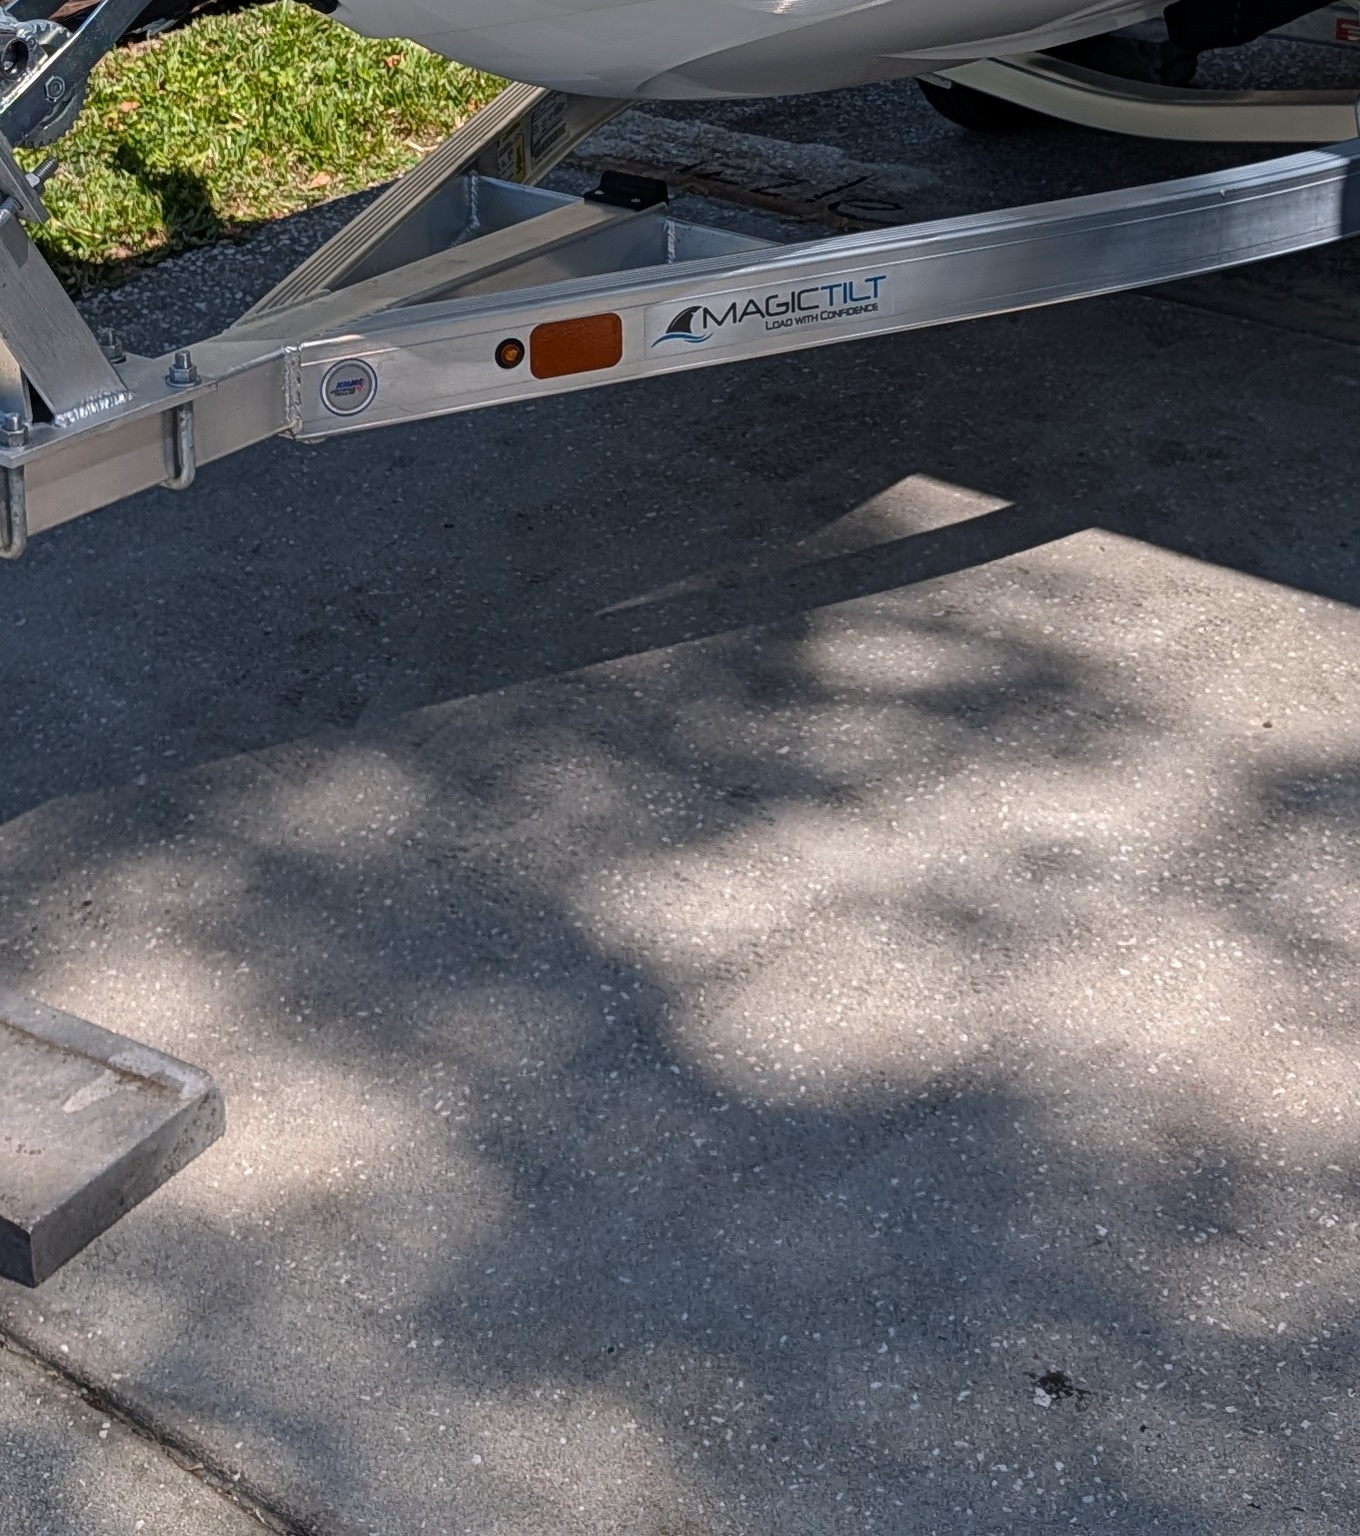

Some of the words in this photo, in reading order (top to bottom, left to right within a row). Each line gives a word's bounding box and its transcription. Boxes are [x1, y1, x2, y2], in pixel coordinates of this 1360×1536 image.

[702, 275, 887, 330] MAGICTILT
[794, 313, 819, 325] WITH
[820, 303, 879, 321] CONFIDENCE
